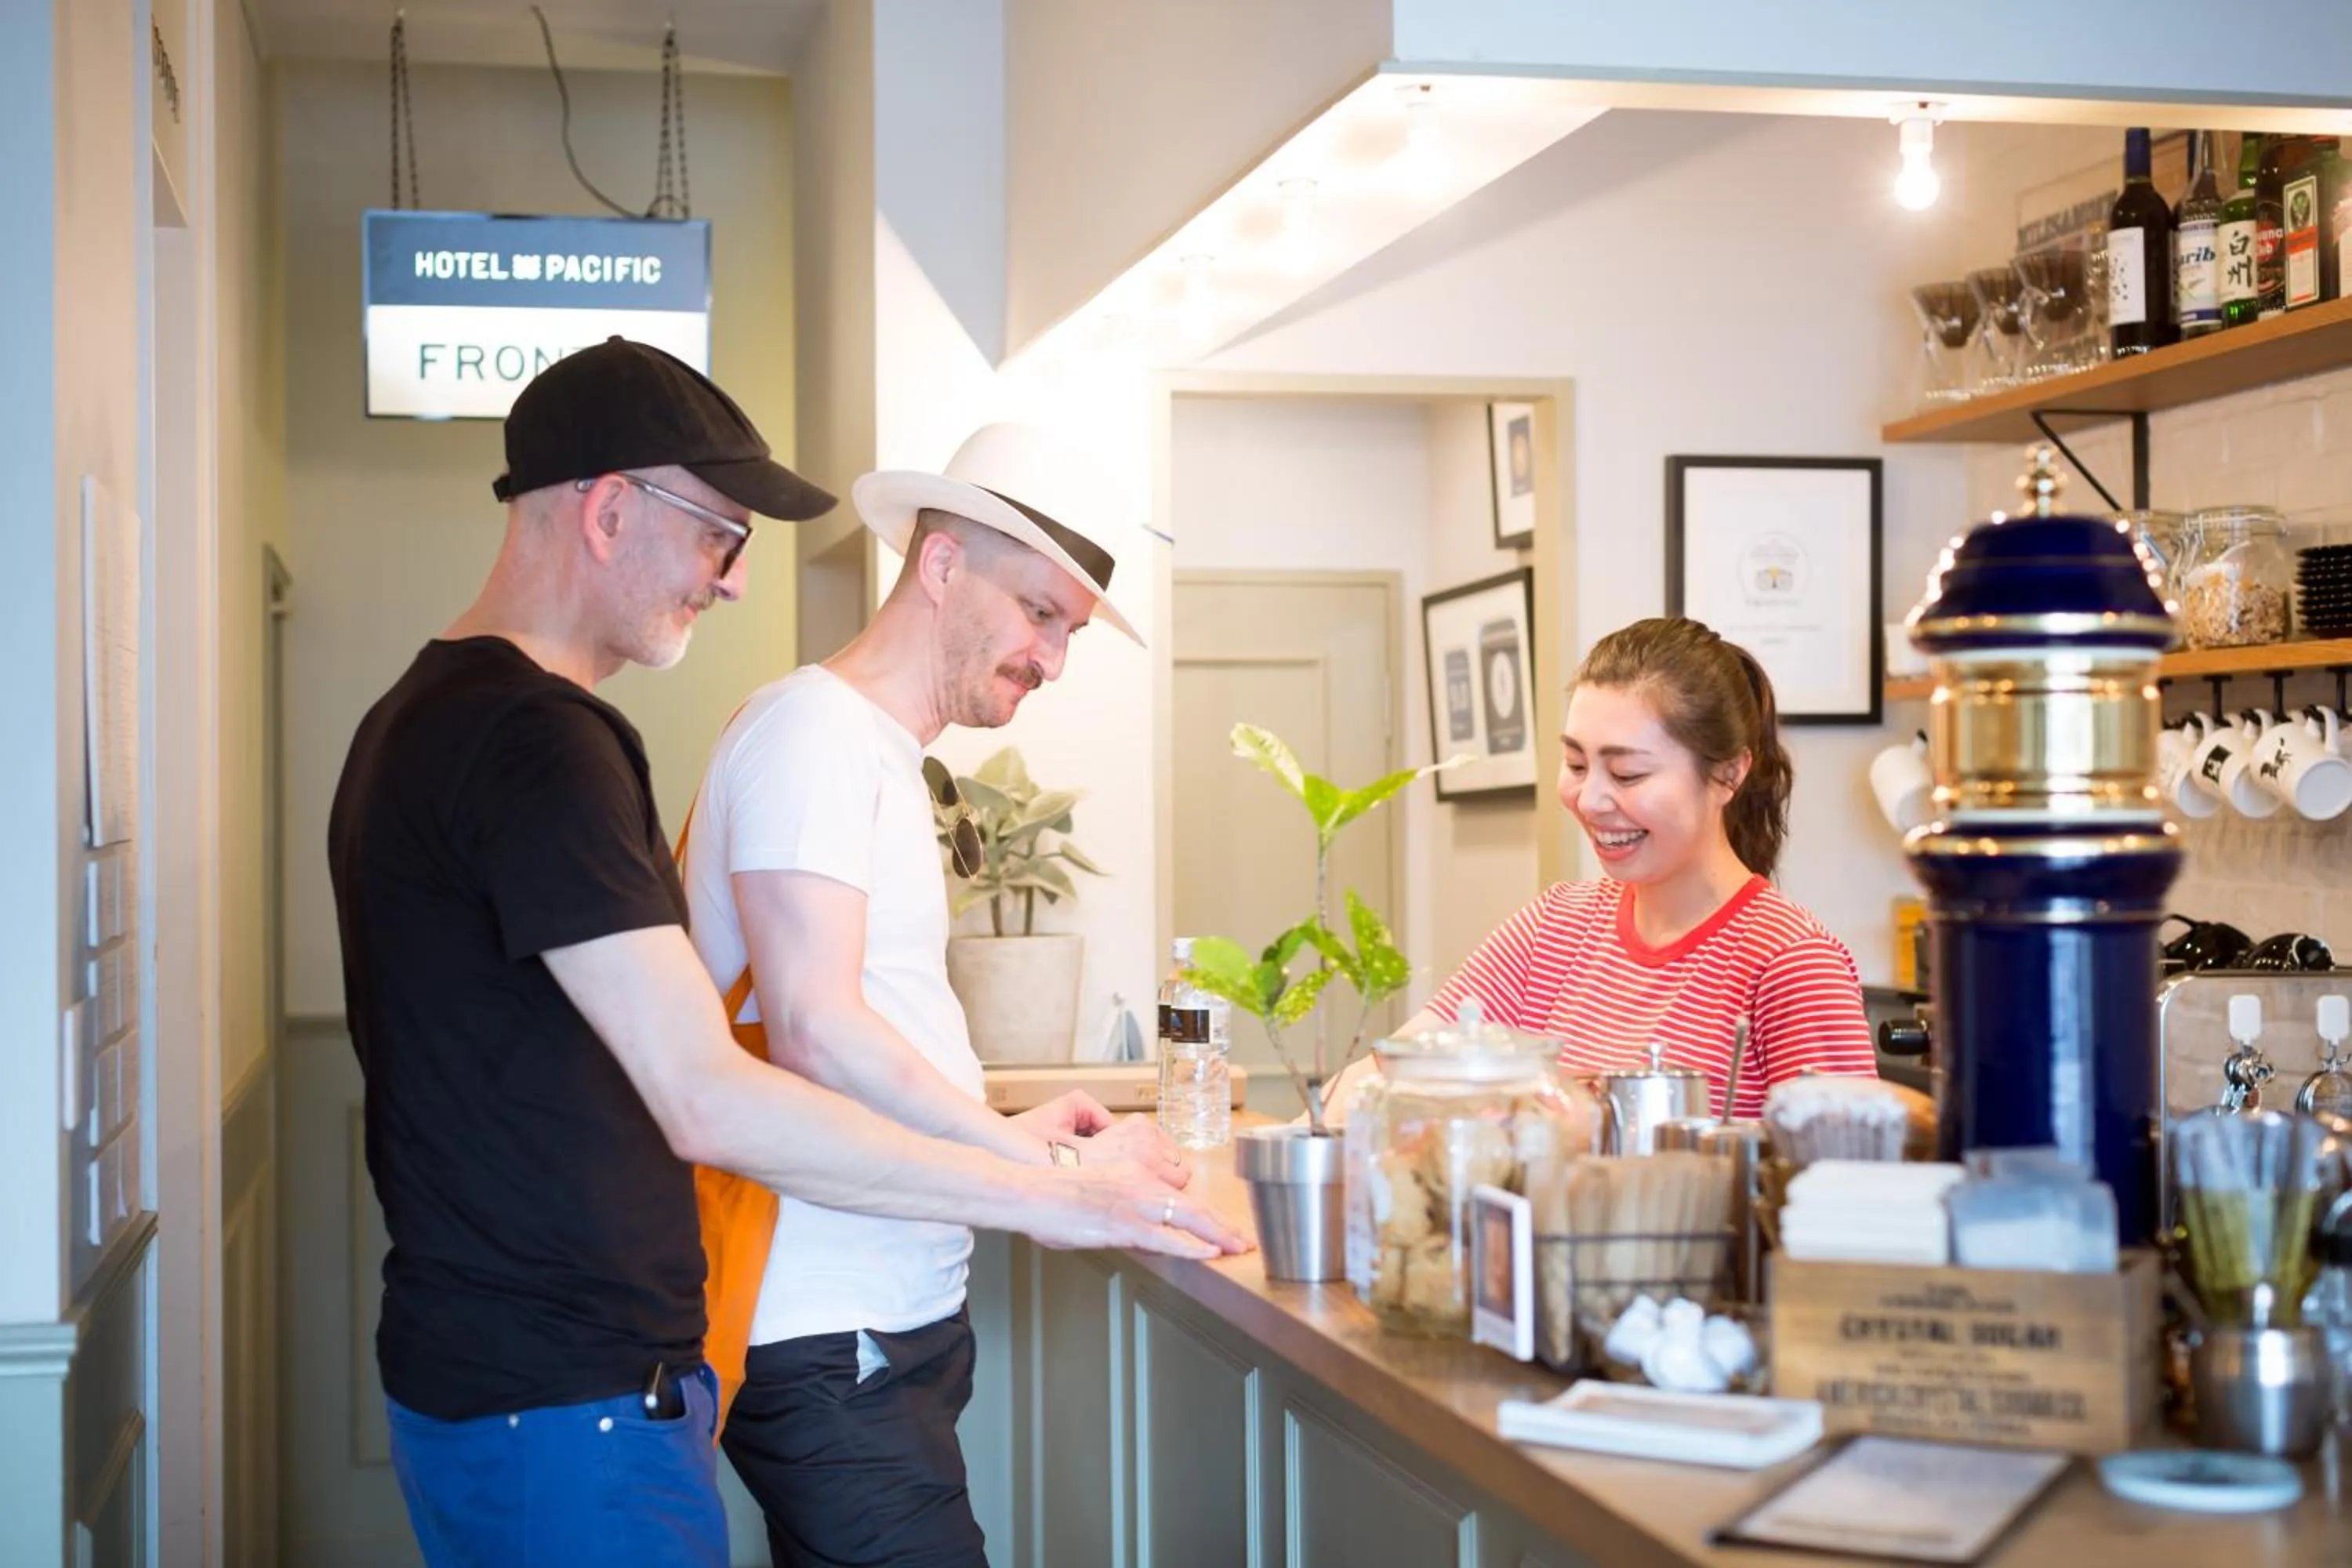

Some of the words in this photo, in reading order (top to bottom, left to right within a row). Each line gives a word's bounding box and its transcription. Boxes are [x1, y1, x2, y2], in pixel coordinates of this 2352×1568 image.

[415, 251, 508, 281] HOTEL
[546, 254, 662, 285] PACIFIC
[2227, 230, 2253, 288] 白州
[419, 343, 591, 382] FRON
